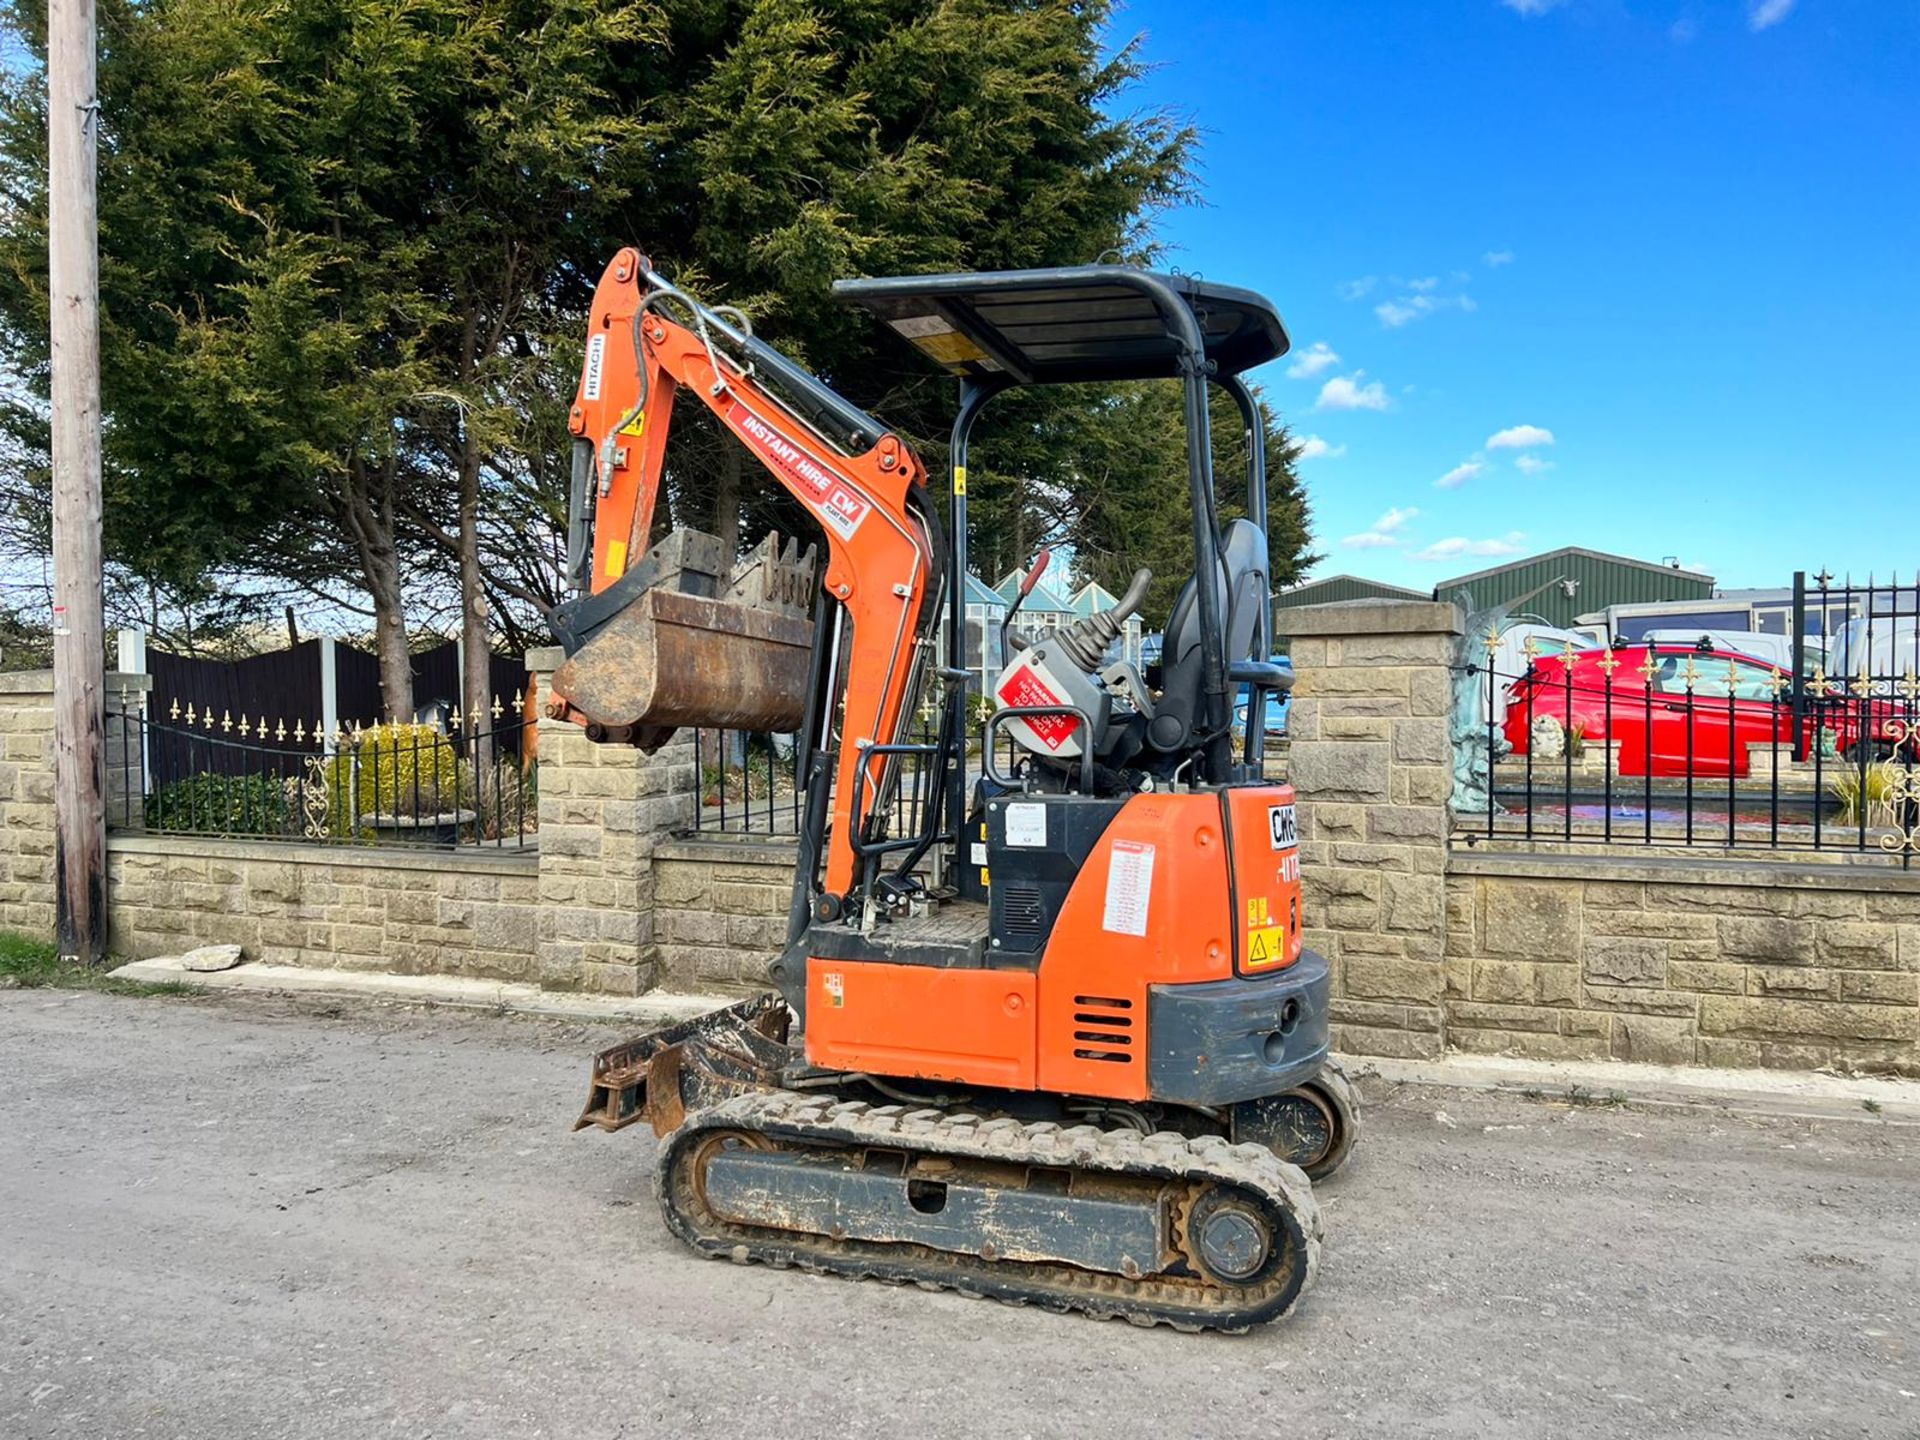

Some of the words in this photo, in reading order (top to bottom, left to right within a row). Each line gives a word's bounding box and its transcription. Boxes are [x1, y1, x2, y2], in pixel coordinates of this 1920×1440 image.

[587, 338, 602, 396] HITACHI
[742, 415, 800, 464] INSTANT
[796, 459, 832, 491] HIRE
[825, 505, 839, 518] PLANT
[830, 489, 860, 516] CW
[1017, 680, 1031, 694] NO
[1017, 691, 1029, 703] TO
[1040, 714, 1054, 728] ON
